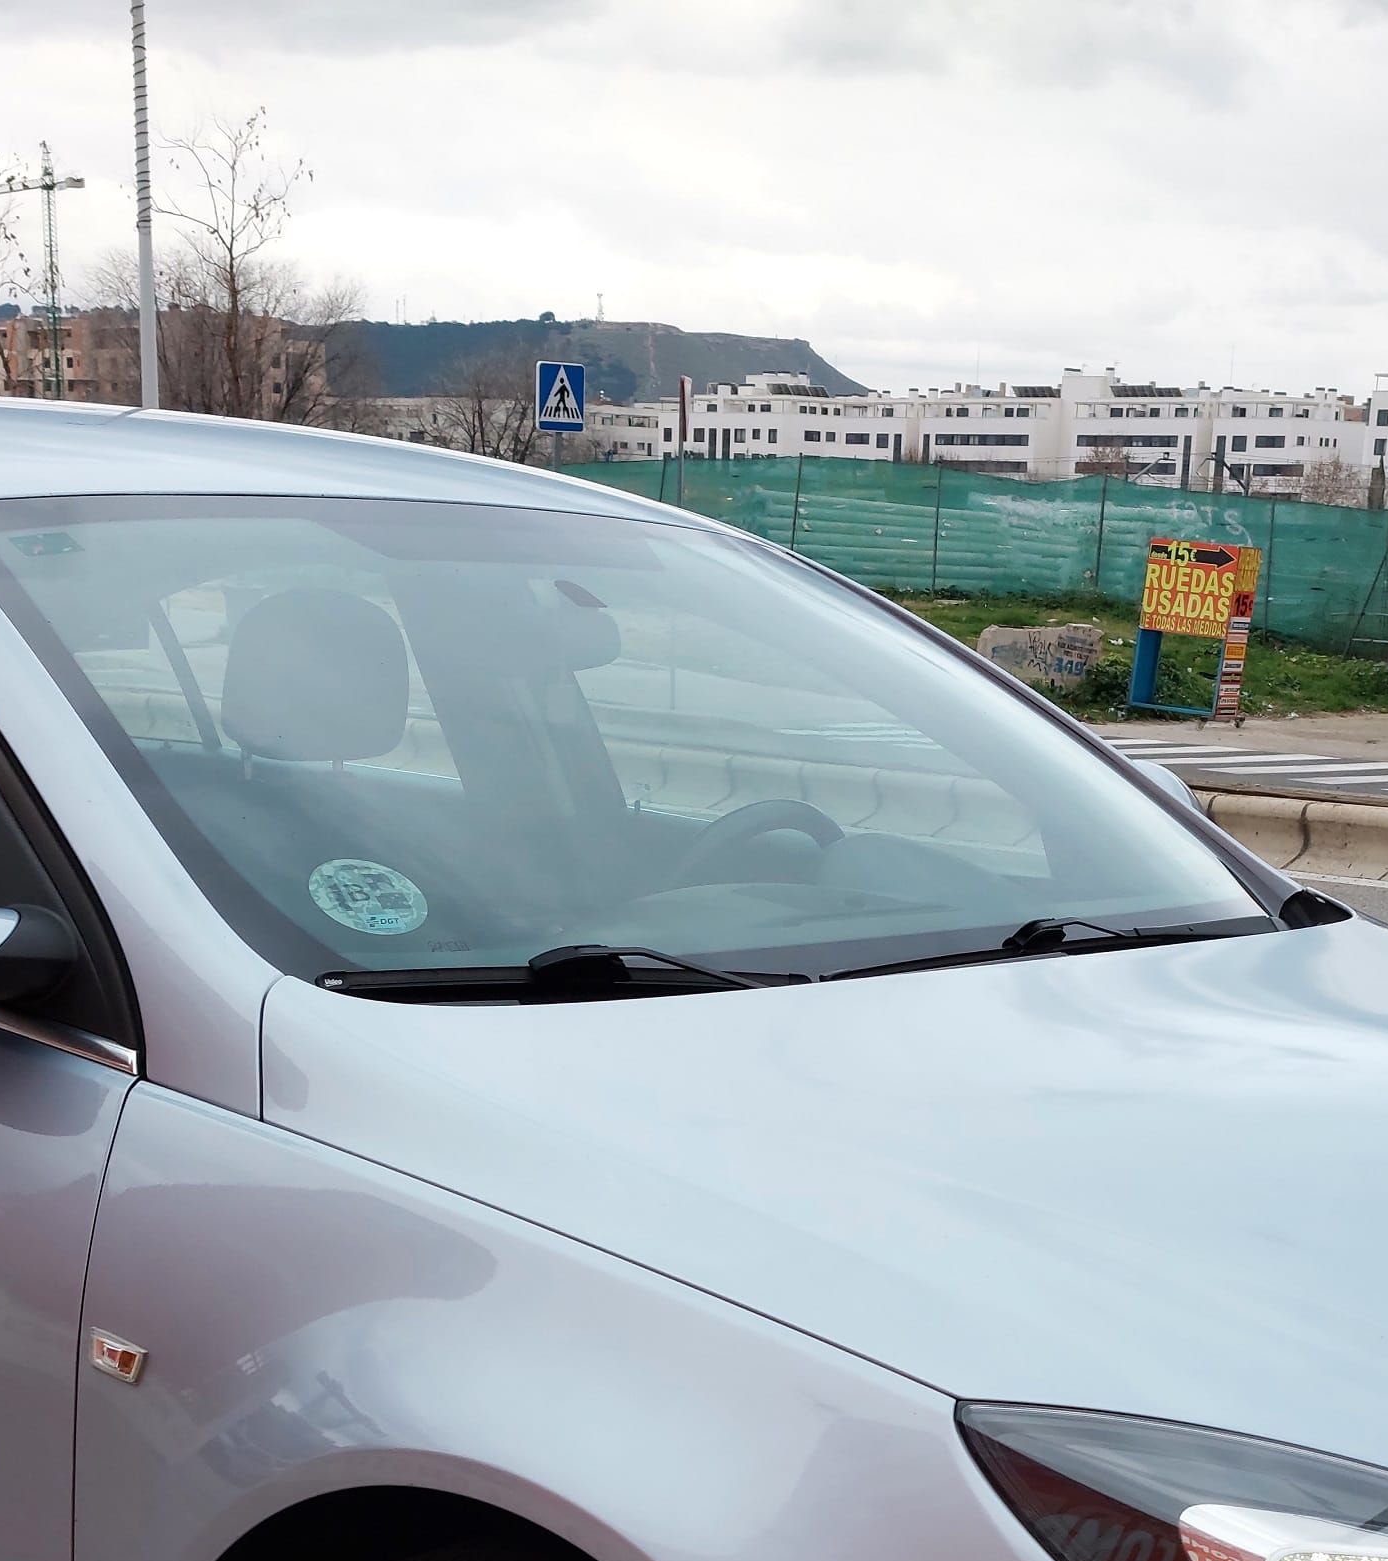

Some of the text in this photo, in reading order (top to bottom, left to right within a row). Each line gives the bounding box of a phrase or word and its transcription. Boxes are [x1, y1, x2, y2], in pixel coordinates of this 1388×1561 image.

[1145, 563, 1235, 597] RUEDAS
[1142, 588, 1230, 622] USADAS
[1140, 614, 1150, 628] DE
[1152, 615, 1176, 631] TODAS
[1176, 617, 1192, 633] LAS
[1193, 619, 1228, 638] MEDIDAS
